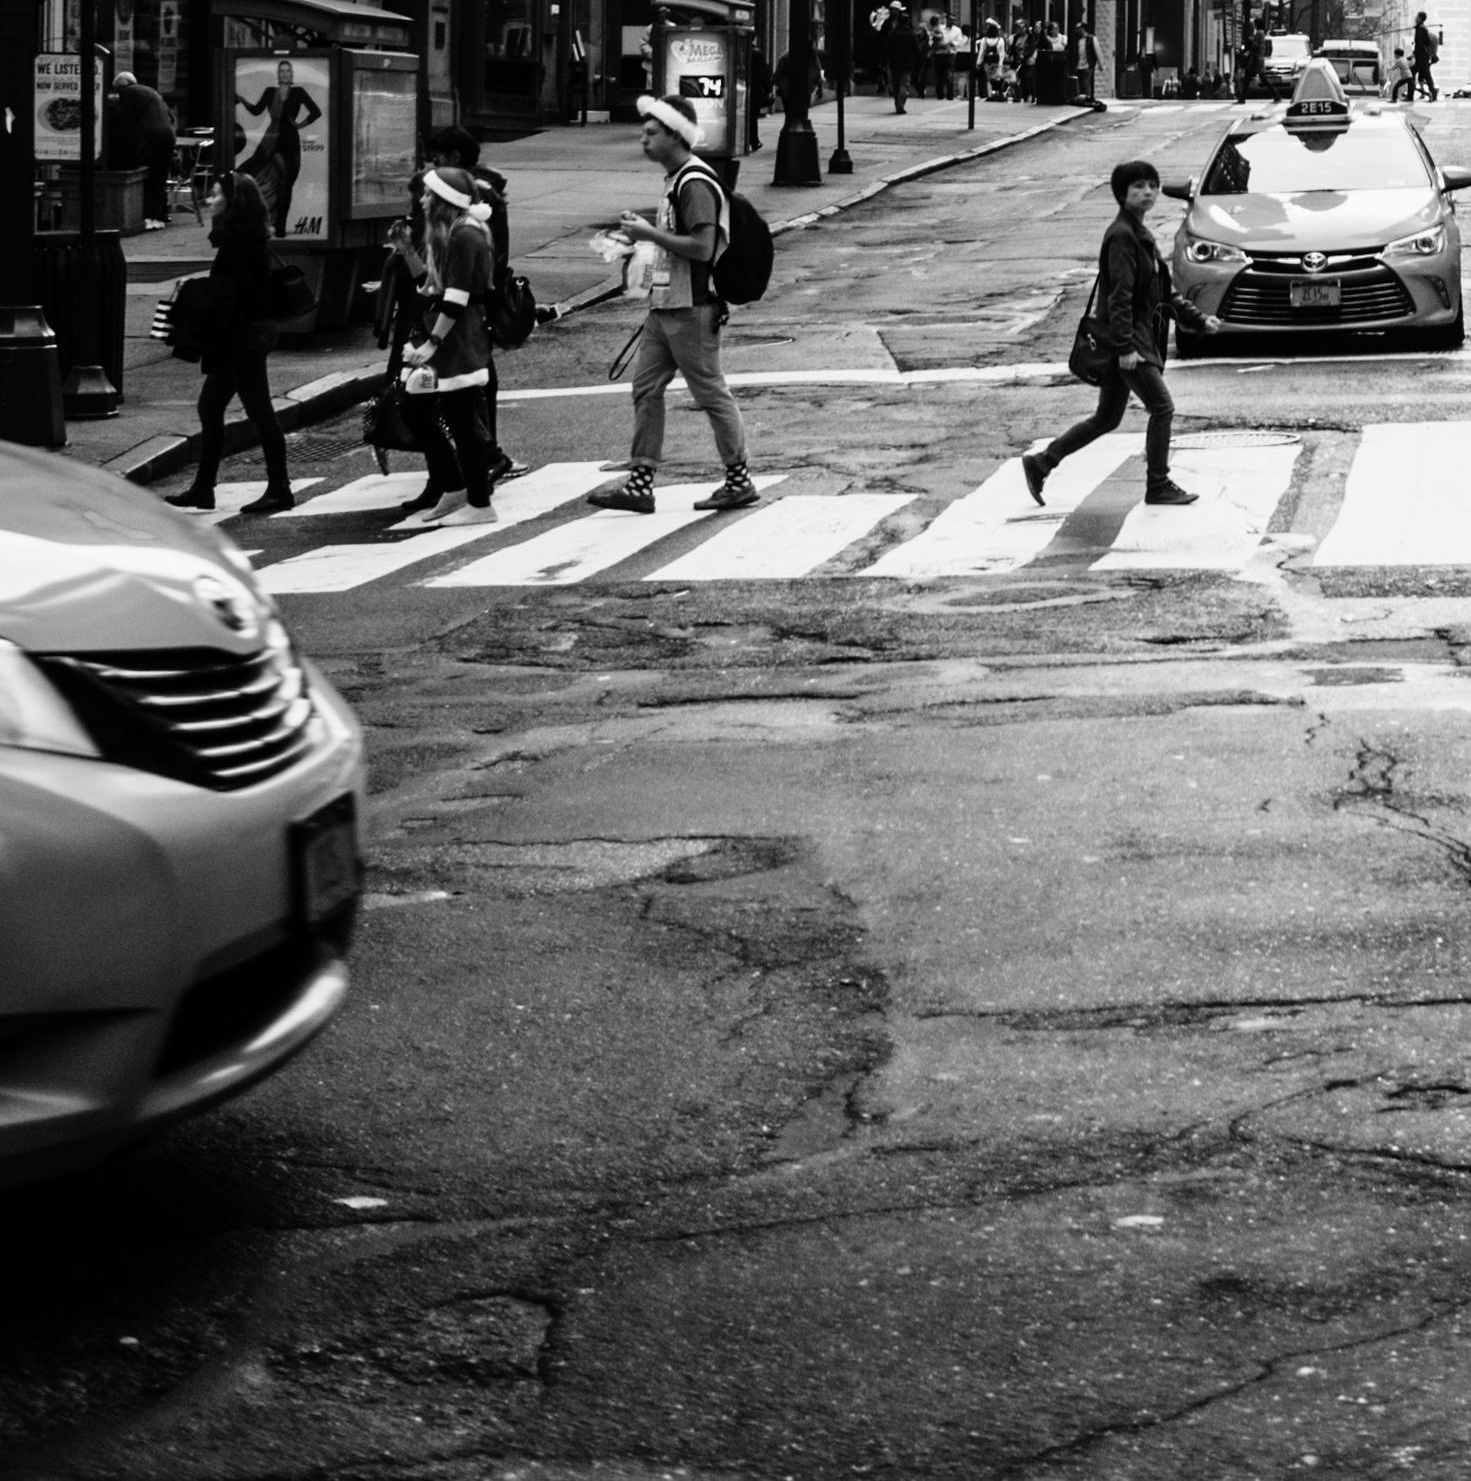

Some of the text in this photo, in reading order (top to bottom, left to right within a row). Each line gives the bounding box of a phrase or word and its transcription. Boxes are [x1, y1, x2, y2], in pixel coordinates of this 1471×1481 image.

[690, 43, 722, 56] MEGA
[37, 63, 51, 75] WE
[53, 82, 79, 91] SERVED
[698, 76, 722, 96] 74
[1301, 101, 1332, 114] 2E15
[294, 216, 323, 235] H&M
